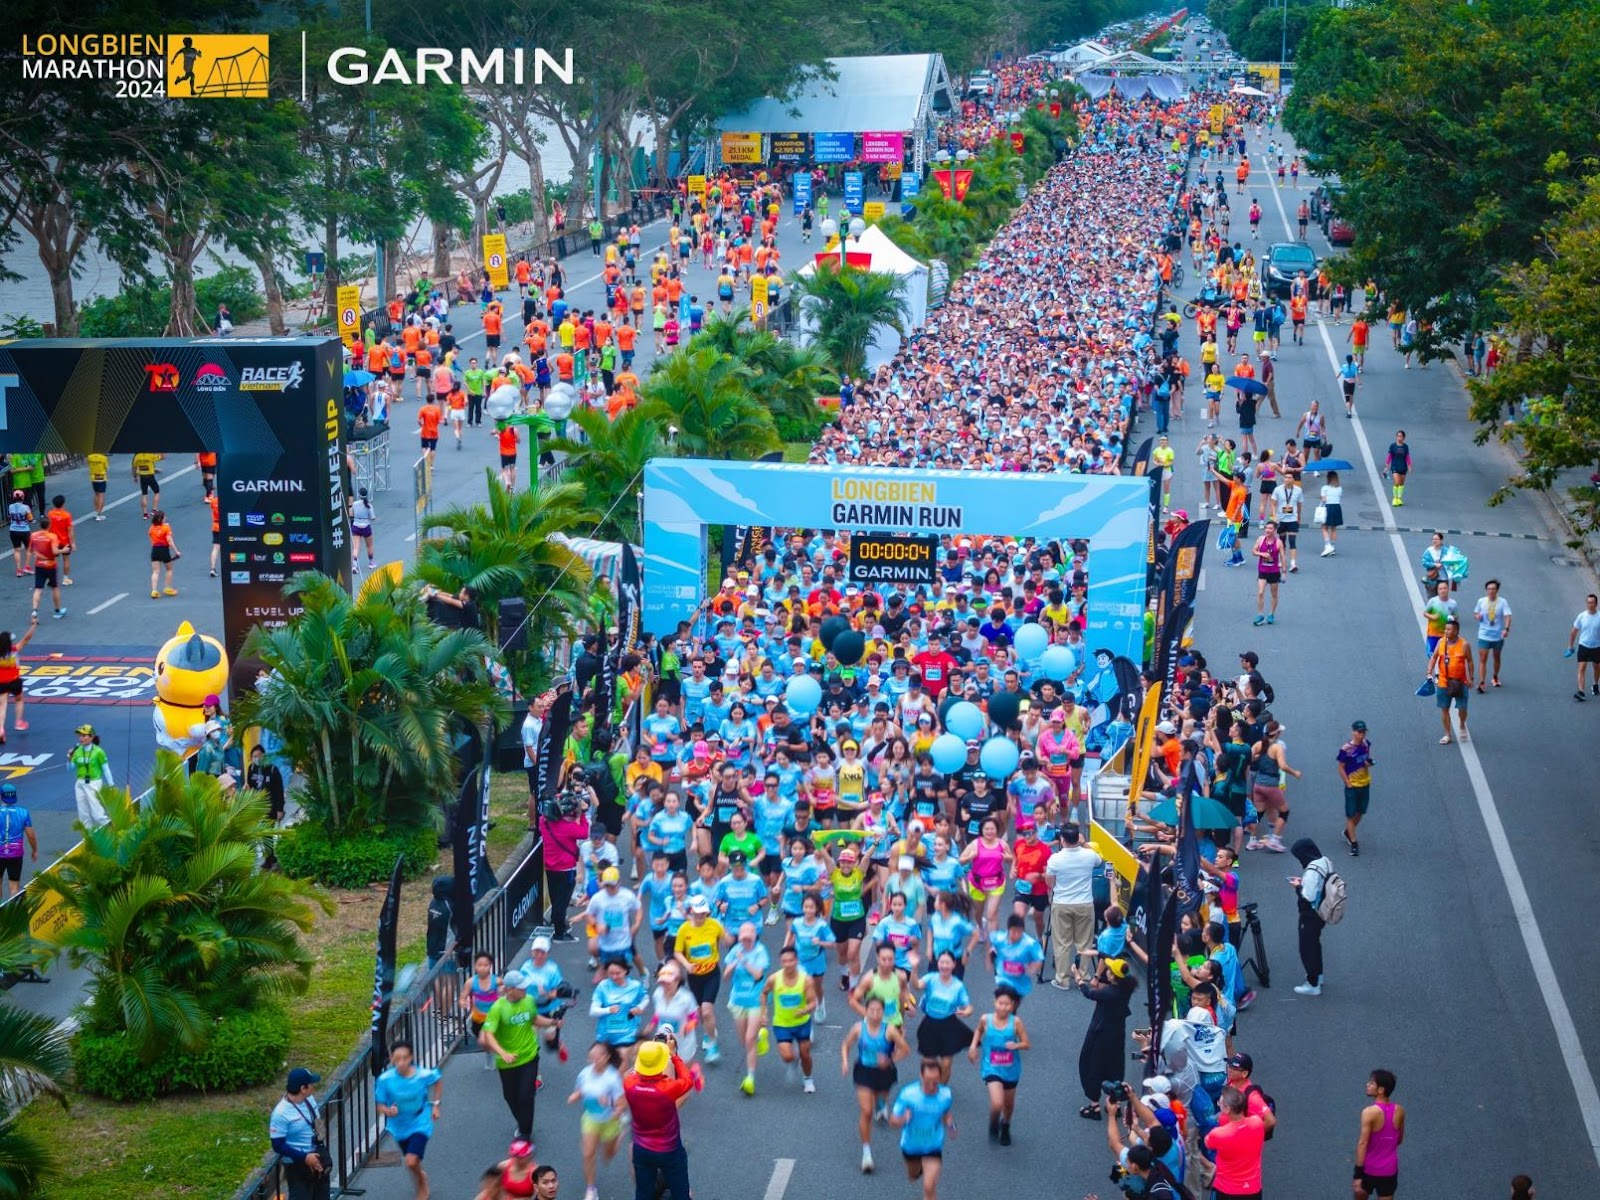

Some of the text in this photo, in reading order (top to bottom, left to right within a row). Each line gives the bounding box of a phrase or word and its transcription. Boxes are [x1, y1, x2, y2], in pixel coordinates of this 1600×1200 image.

[241, 367, 289, 381] RACE
[232, 480, 303, 492] GARMIN
[832, 479, 936, 503] LONGBIEN
[832, 503, 962, 528] GARMIN RUN
[859, 542, 930, 560] 00:00:04
[854, 565, 930, 580] GARMIN
[245, 607, 304, 616] LEVEL UP
[512, 881, 539, 928] GARMIN
